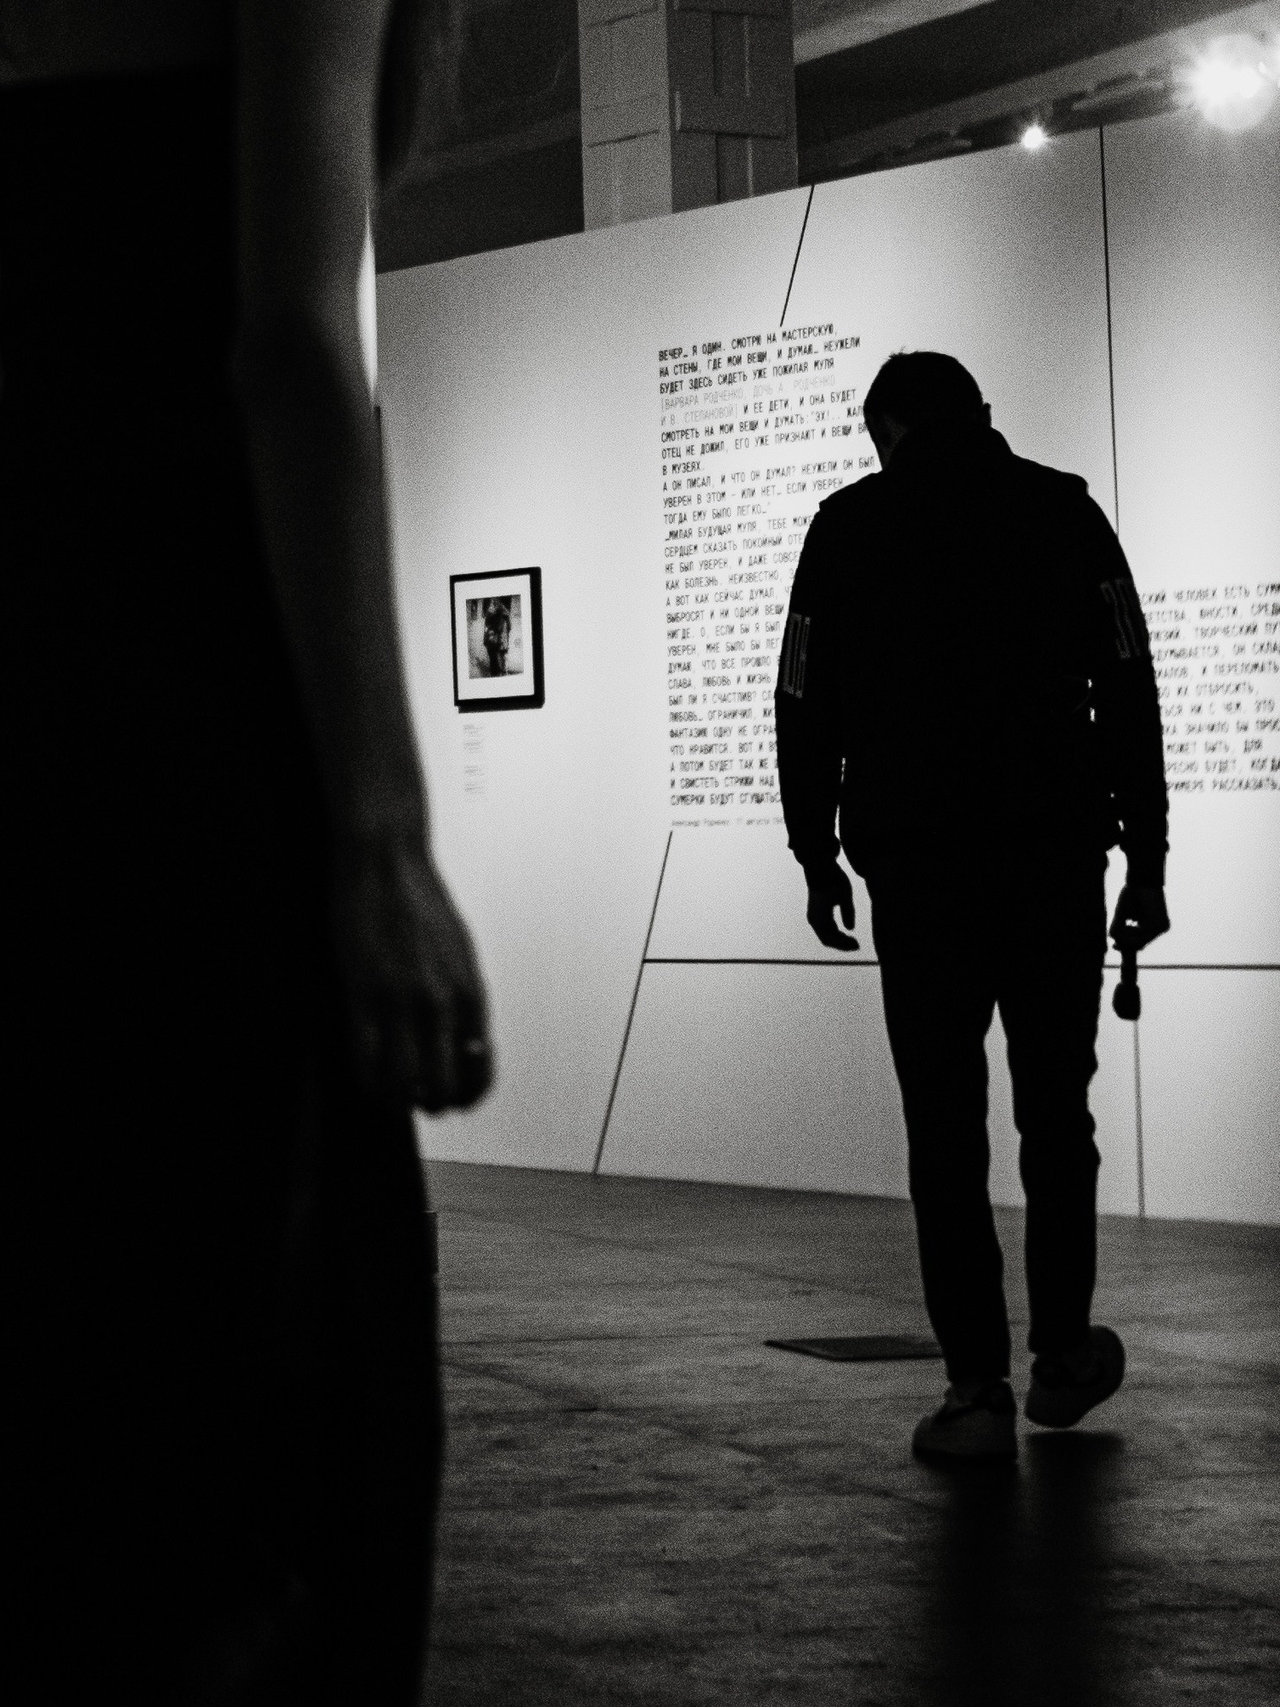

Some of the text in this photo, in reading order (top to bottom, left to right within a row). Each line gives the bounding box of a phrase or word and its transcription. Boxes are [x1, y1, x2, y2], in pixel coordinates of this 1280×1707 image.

[707, 357, 723, 371] ГДЕ
[727, 354, 743, 367] МОИ
[823, 336, 860, 354] НЕУЖЕЛИ
[732, 334, 762, 350] СМОТРЮ
[659, 357, 834, 395] БУДЕТ ЗДЕСЬ СИДЕТЬ УЖЕ ПОЖИЛАЯ МУЛЯ
[809, 393, 825, 407] ОНА
[830, 388, 856, 404] БУДЕТ
[660, 427, 699, 443] СМОТРЕТЬ
[719, 423, 734, 436] МОИ
[739, 419, 760, 433] ВЕЩИ
[661, 446, 682, 460] ОТЕЦ
[734, 436, 750, 451] ЕГО
[755, 434, 770, 448] УЖЕ
[774, 428, 815, 446] ПРИЗНАЮТ
[831, 424, 852, 439] ВЕЩИ
[730, 471, 746, 485] ЧТО
[765, 465, 795, 481] ДУМАЛ?
[801, 460, 838, 477] НЕУЖЕЛИ
[857, 455, 874, 470] БЫЛ
[662, 494, 692, 509] УВЕРЕН
[706, 490, 726, 504] ЭТОМ
[741, 487, 756, 500] ИЛИ
[786, 481, 807, 495] ЕСЛИ
[812, 477, 843, 493] УВЕРЕН
[663, 506, 732, 526] ТОГДА ЕМУ БЫЛО
[697, 523, 732, 539] БУДУЩАЯ
[767, 517, 787, 532] ТЕБЕ
